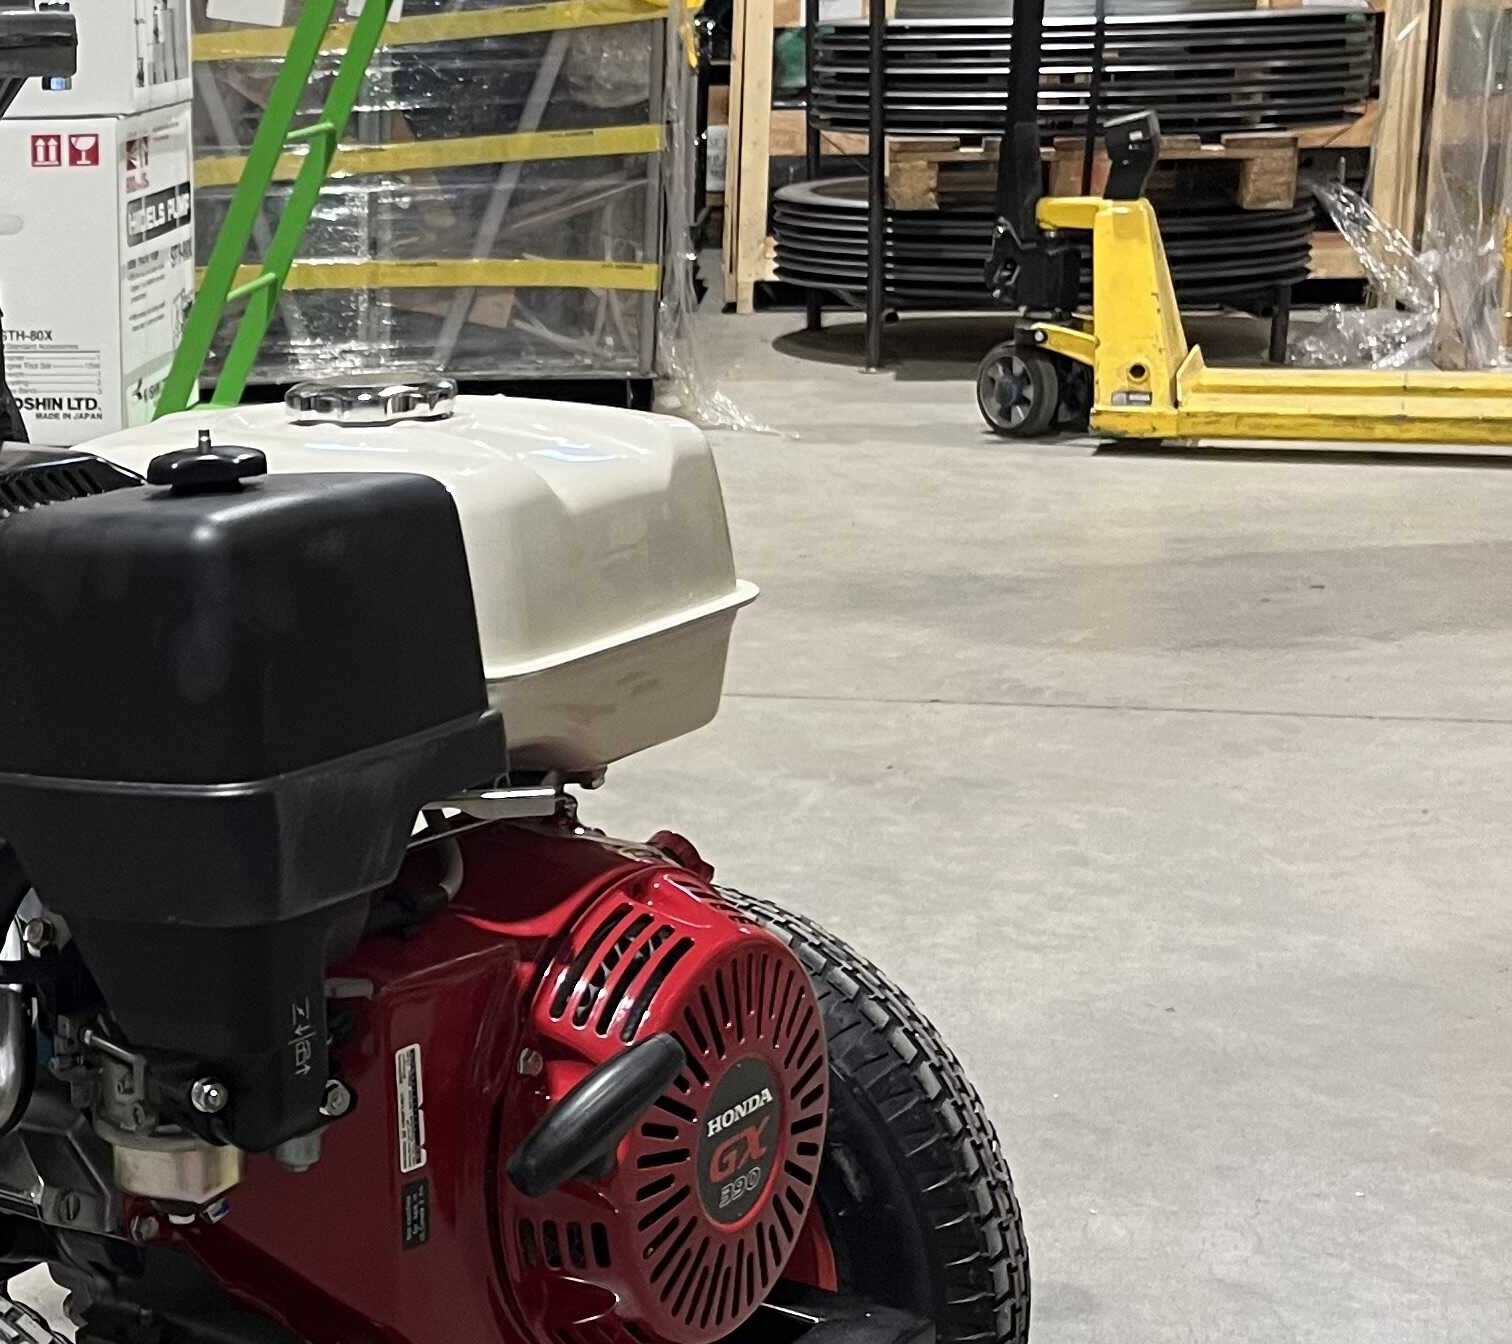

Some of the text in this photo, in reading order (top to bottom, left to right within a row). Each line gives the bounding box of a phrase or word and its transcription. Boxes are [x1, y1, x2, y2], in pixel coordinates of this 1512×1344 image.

[14, 396, 102, 412] OSHIN LTD.
[73, 412, 103, 420] JAPAN
[707, 1087, 773, 1138] HONDA
[709, 1115, 771, 1184] GX
[718, 1166, 762, 1209] 390
